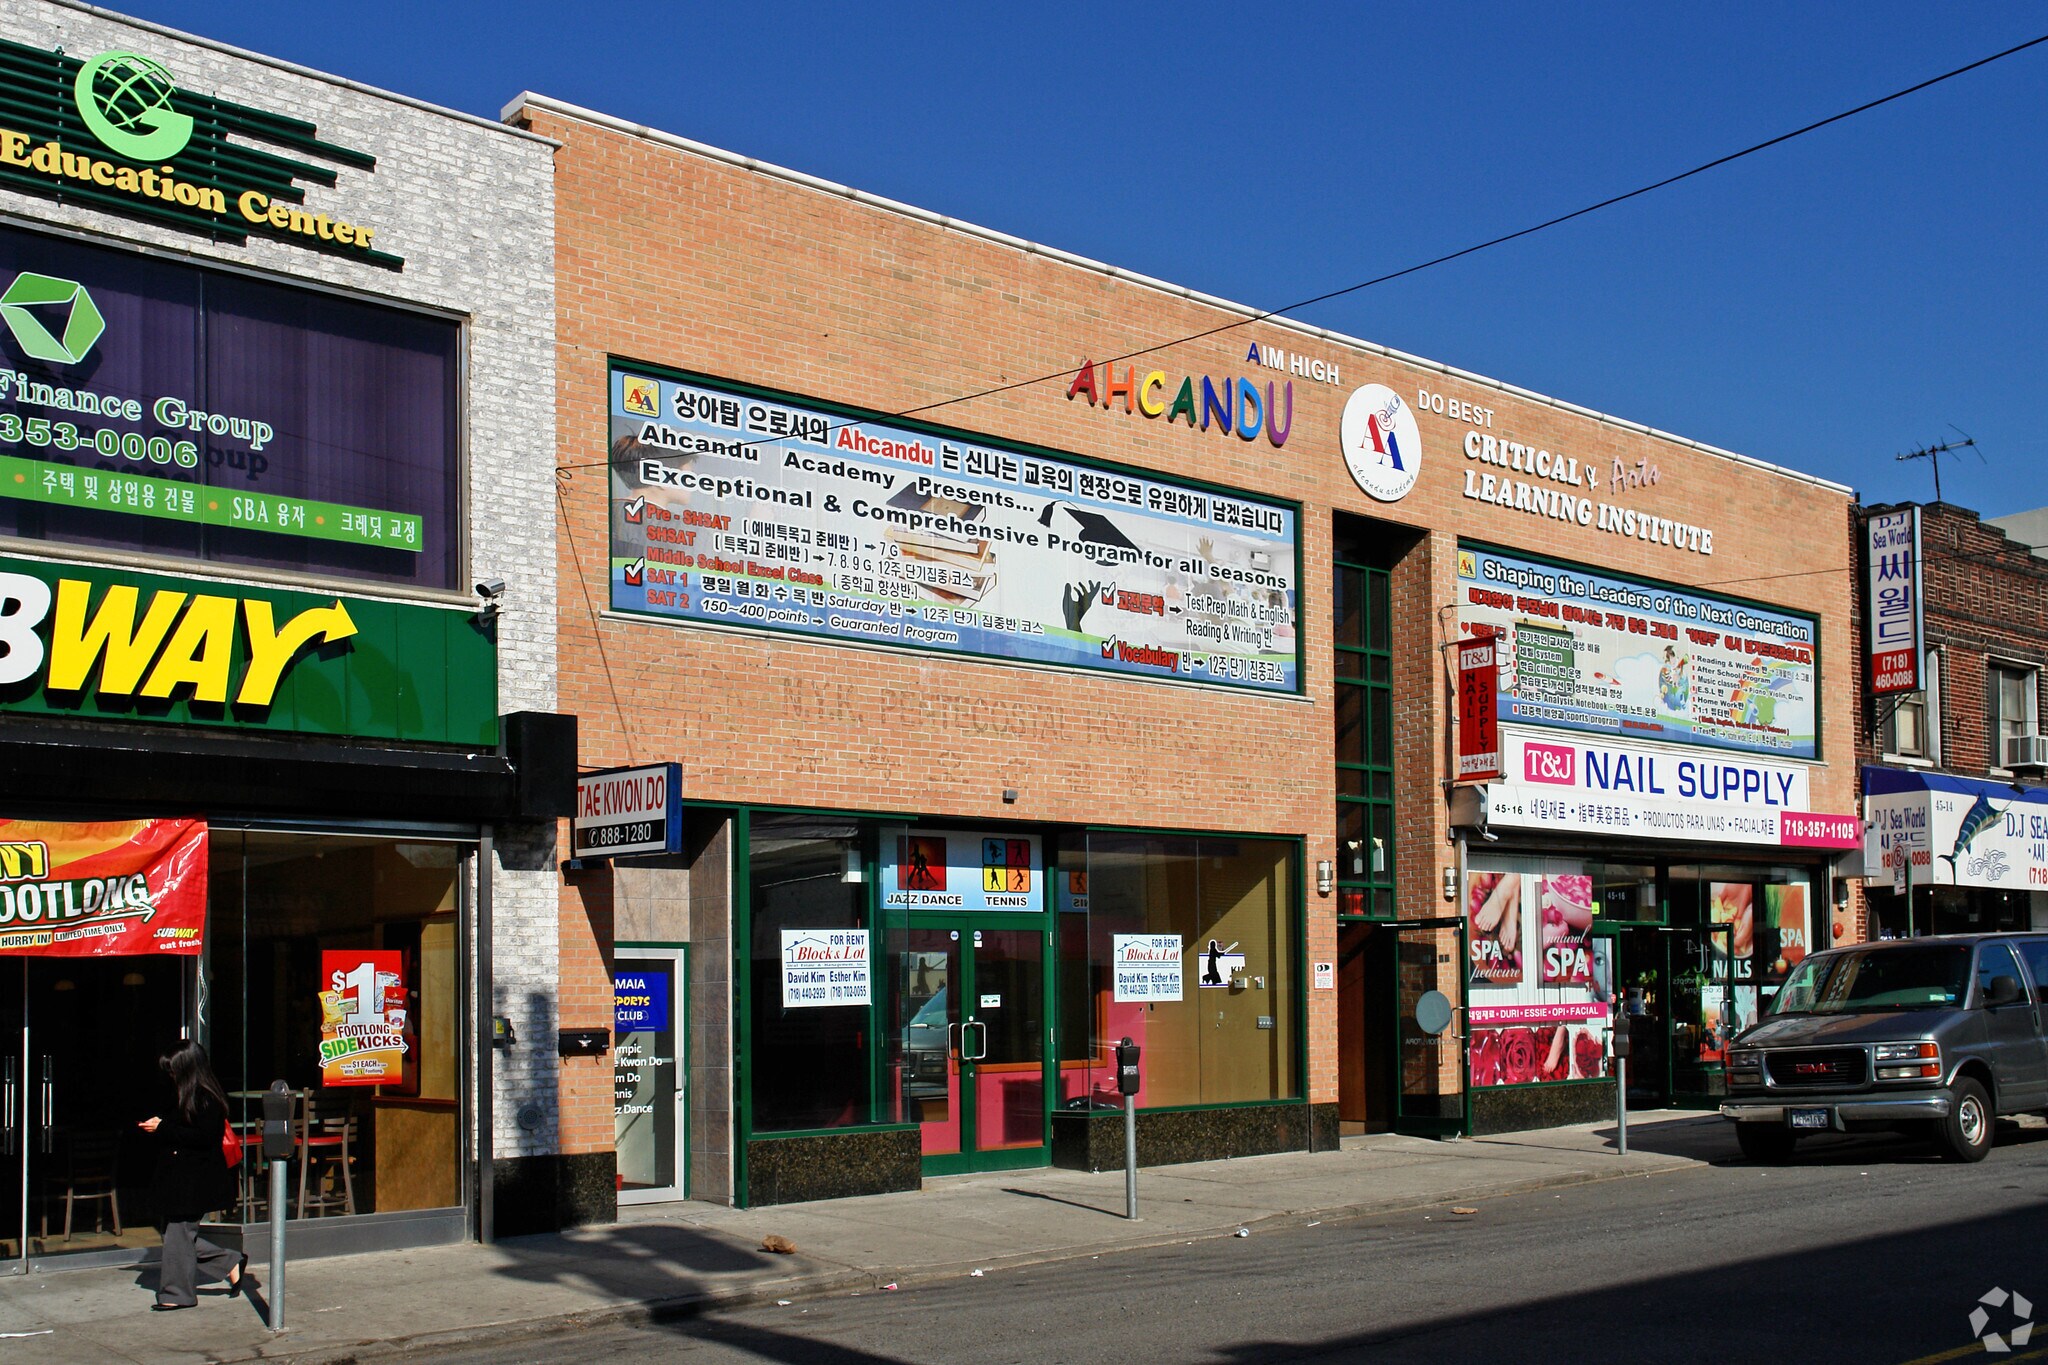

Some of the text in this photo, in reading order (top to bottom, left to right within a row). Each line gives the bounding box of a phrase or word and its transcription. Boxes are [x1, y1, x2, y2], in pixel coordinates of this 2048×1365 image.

[0, 129, 375, 247] Education Center
[1246, 342, 1340, 386] AIM HIGH
[1066, 358, 1293, 448] AHCANDU
[1418, 389, 1494, 428] DO BEST
[154, 397, 273, 450] Group
[0, 413, 198, 468] 353-0006
[675, 390, 740, 424] 상아탑
[838, 428, 934, 465] Ahcandu
[943, 445, 959, 471] 는
[965, 450, 1017, 482] 신나는
[1024, 461, 1072, 493] 교육의
[1079, 474, 1142, 505] 현장으로
[1149, 488, 1207, 519] 유일하게
[1464, 430, 1662, 495] CRITICAL Arts
[641, 425, 1034, 511] Ahcandu Academy Presents...
[42, 470, 415, 544] 주택 및 상업용 건물 SBA 크레딧 교정
[647, 506, 731, 531] Pre SHSAT
[1464, 469, 1713, 555] LEARNING INSTITUTE
[643, 462, 1287, 589] Exceptional Comprehensive Program for all seasons
[647, 525, 696, 546] SHSAT
[1873, 527, 1912, 549] Sea World
[647, 547, 823, 585] Middle School Excel Class
[647, 568, 1044, 634] SAT 월 화 수 목 반 Saturday 반 12주 단기 집중반 코스
[1185, 593, 1290, 626] Test Prep Math English
[1483, 559, 1809, 642] Shaping the Leaders of the Next Generation
[1878, 550, 1912, 645] 씨월드
[647, 589, 958, 643] SAT points Program
[1187, 619, 1272, 649] Reading Writing 반
[1117, 641, 1191, 672] Vocabulary 반
[1536, 651, 1562, 661] system
[1697, 655, 1760, 673] Reading Writing
[1882, 653, 1908, 671] (718)
[1536, 665, 1557, 675] clinic
[1697, 666, 1716, 676] After
[1717, 669, 1741, 679] School
[1743, 674, 1771, 686] Program
[1875, 672, 1913, 689] 460-0088
[1466, 673, 1476, 718] NAIL
[1698, 676, 1804, 701] Music Drum
[1543, 694, 1607, 710] Analysis Notebook
[1698, 697, 1718, 706] Home
[1478, 682, 1488, 751] SUPPLY
[1567, 713, 1588, 723] sports
[1591, 716, 1619, 726] program
[1526, 750, 1794, 806] T&J NAIL SUPPLY
[604, 778, 642, 815] KWON
[646, 775, 665, 811] DO
[1530, 799, 1725, 832] 네일재료 指甲美容用品 PRODUCTOS PARA UNAS
[1890, 810, 1903, 829] Sea
[600, 823, 651, 845] 888-1280
[887, 894, 1027, 907] JAZZ DANCE TENNIS
[1, 923, 126, 946] HURRY IN! LIMITED TIME ONLY.
[153, 928, 198, 938] SUBWAY
[830, 935, 864, 945] FOR RENT
[1780, 928, 1805, 948] SPA
[160, 942, 177, 950] eat
[798, 946, 865, 961] Block Lot
[1471, 939, 1503, 961] SPA
[1546, 947, 1590, 977] SPA
[788, 970, 866, 984] David Kim Esther Kim
[617, 1011, 643, 1021] CLUB
[1500, 1009, 1519, 1019] DURI
[1524, 1008, 1547, 1018] ESSIE
[1552, 1007, 1566, 1016] OPI
[1570, 1004, 1599, 1015] FACIAL
[337, 1024, 390, 1039] FOOTLONG
[321, 1035, 401, 1060] SIDEKICKS
[621, 1057, 663, 1067] Kwon Do
[1796, 1063, 1837, 1074] GMC
[627, 1073, 641, 1082] Do
[624, 1105, 653, 1114] Dance
